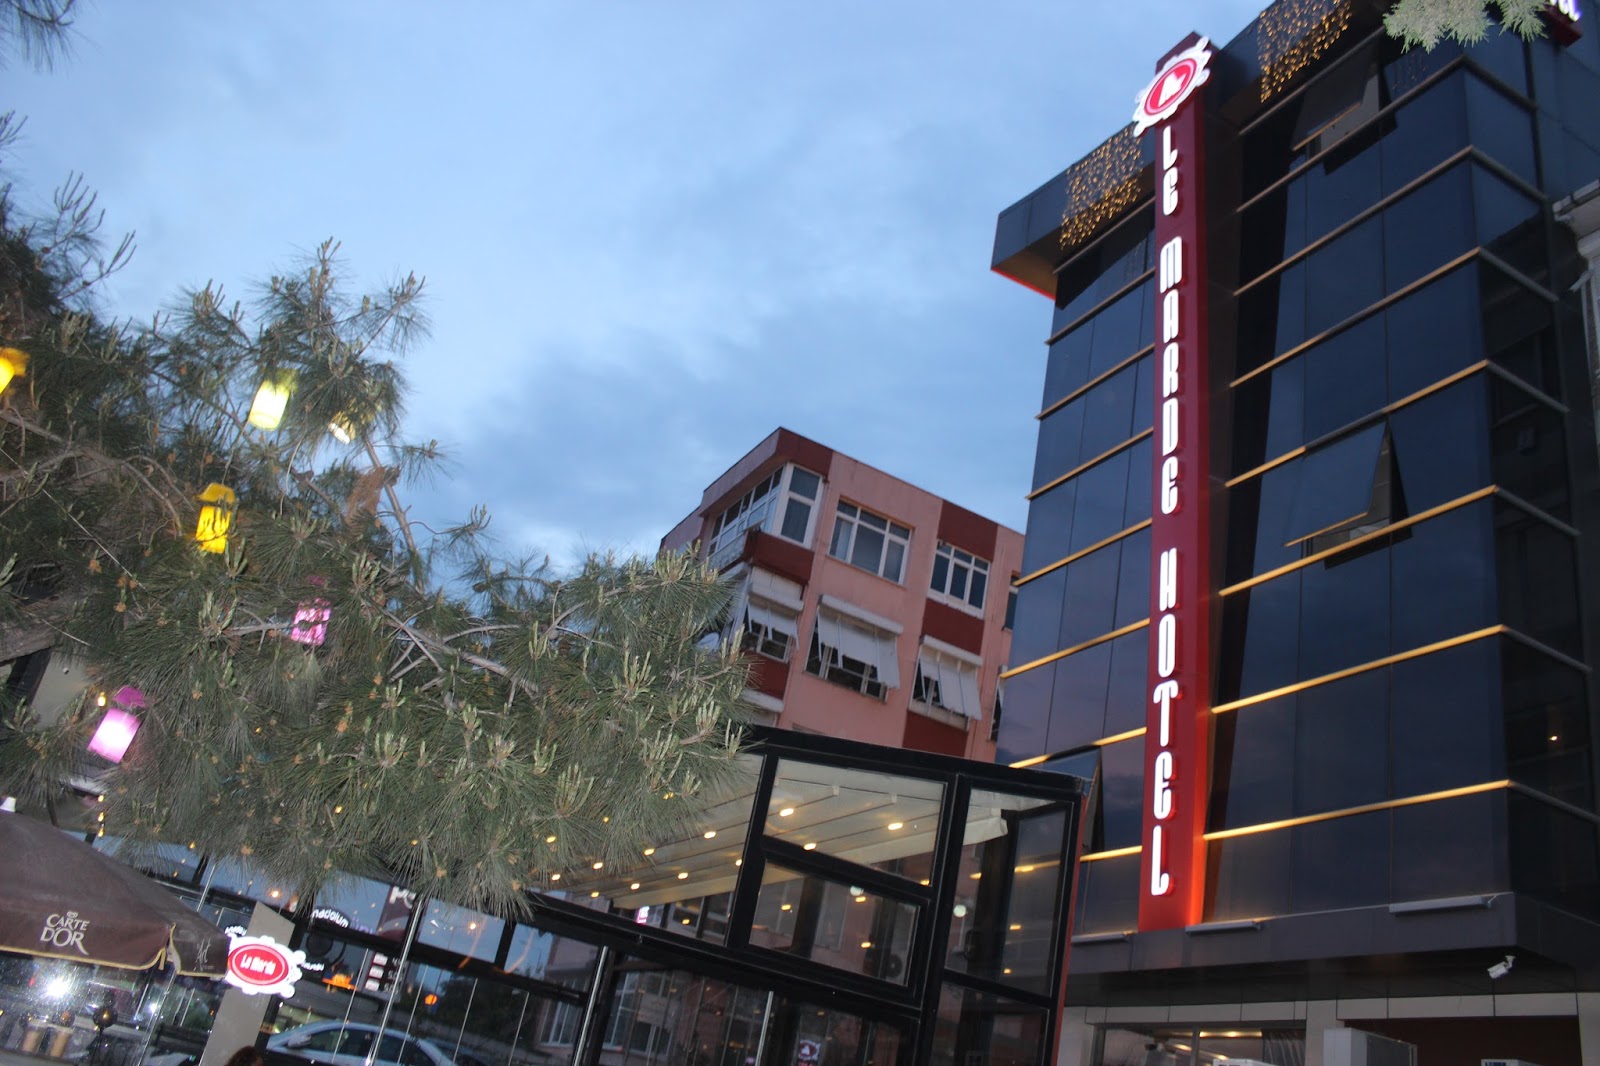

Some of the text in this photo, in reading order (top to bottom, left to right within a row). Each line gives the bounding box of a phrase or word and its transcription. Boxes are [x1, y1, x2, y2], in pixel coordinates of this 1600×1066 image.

[1162, 125, 1179, 216] LE
[1159, 236, 1183, 515] MARDE
[1150, 548, 1178, 896] HOTEL
[46, 914, 90, 931] CARTE
